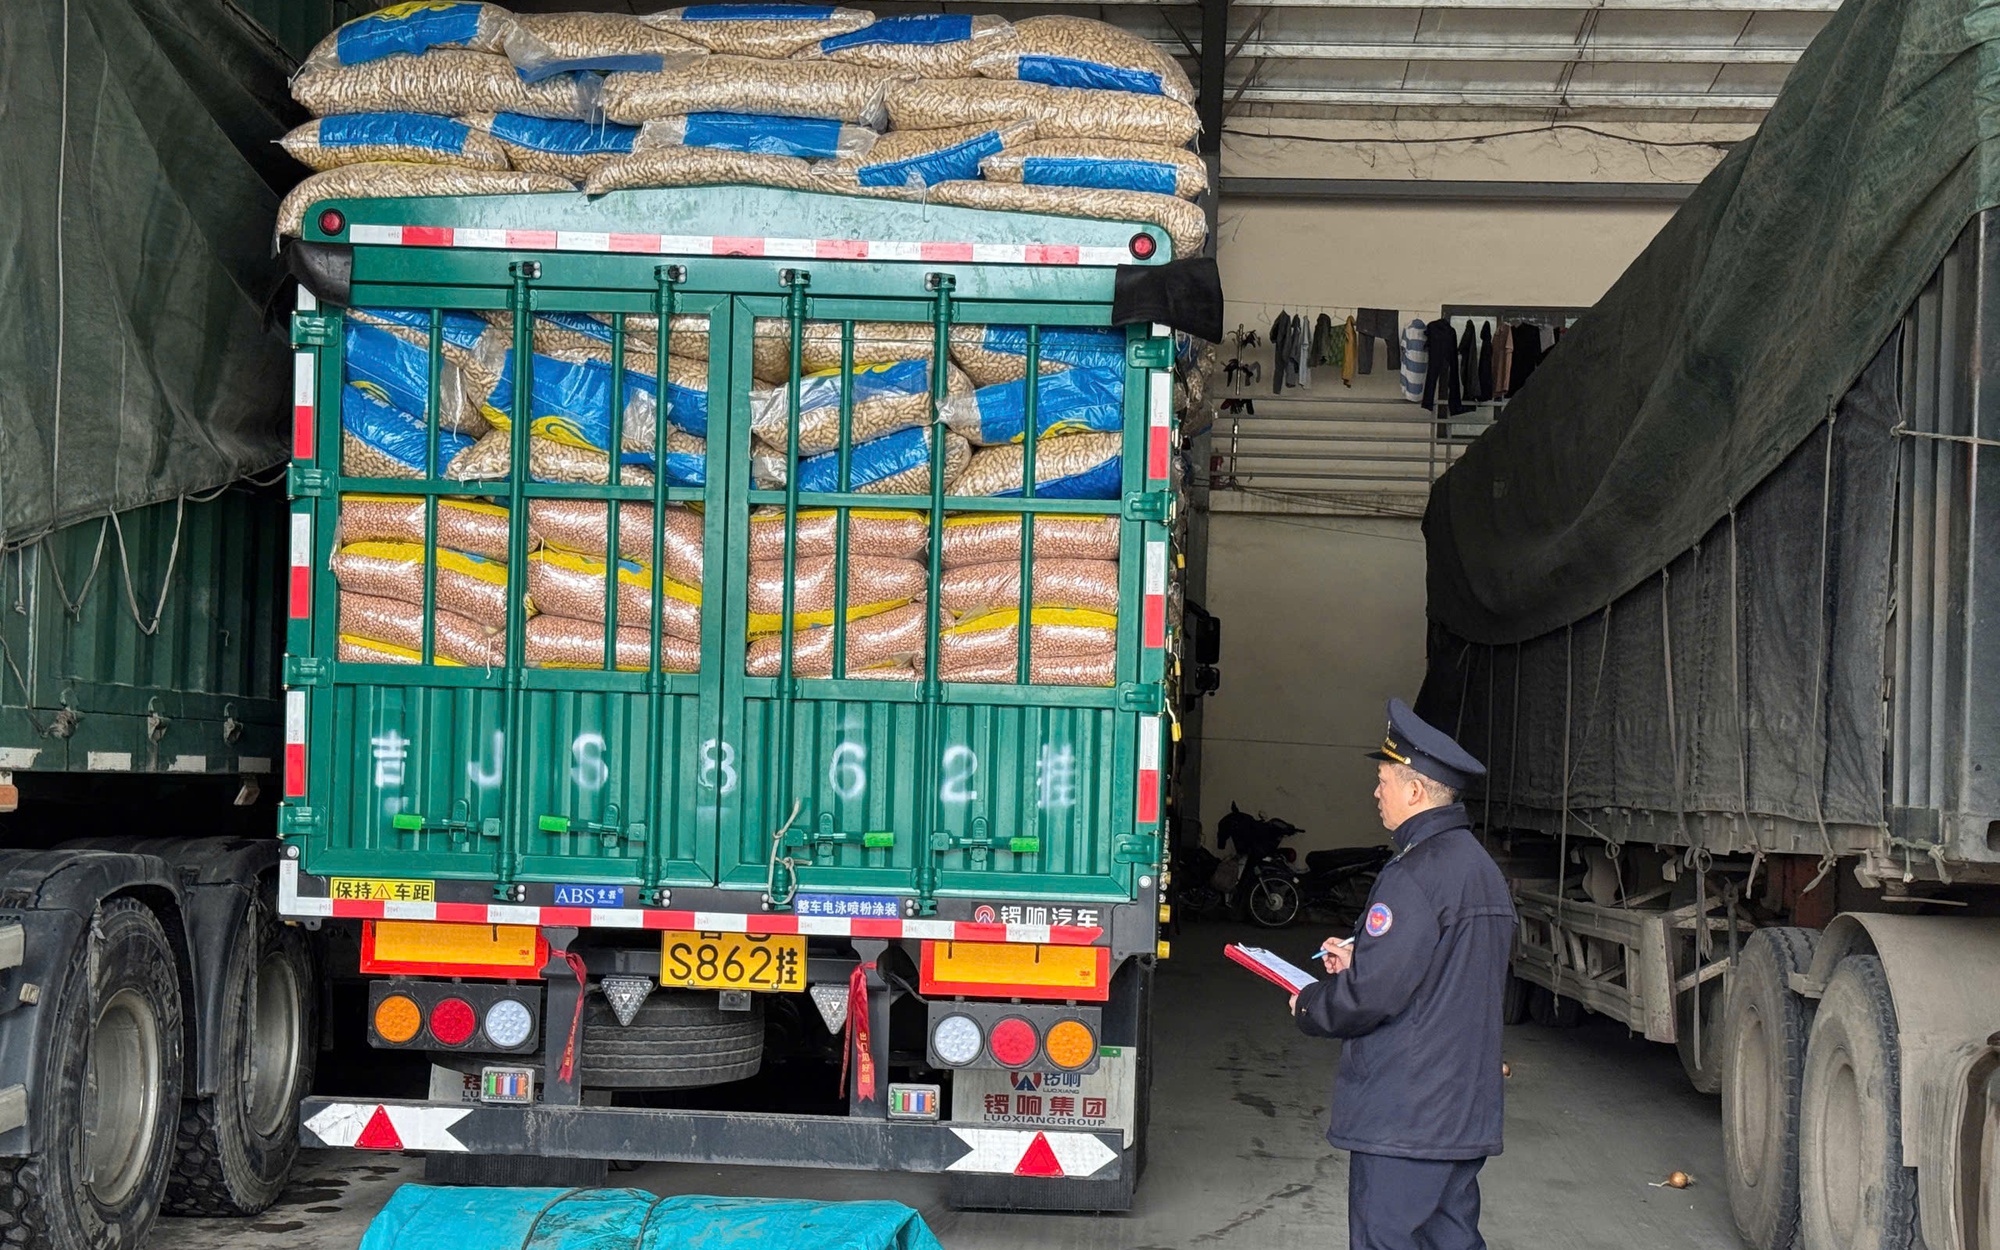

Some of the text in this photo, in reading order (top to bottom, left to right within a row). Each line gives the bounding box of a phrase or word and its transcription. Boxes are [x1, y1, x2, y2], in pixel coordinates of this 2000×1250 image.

[335, 881, 430, 901] 保持 车距
[555, 888, 594, 904] ABS
[797, 899, 898, 916] 整车电泳喷粉涂装
[1001, 905, 1098, 928] 锣响汽车
[669, 942, 797, 984] S862挂
[1043, 1087, 1080, 1095] LUOXIANG
[984, 1093, 1107, 1119] 锣响集团
[983, 1114, 1106, 1127] LUOXIANGGROUP
